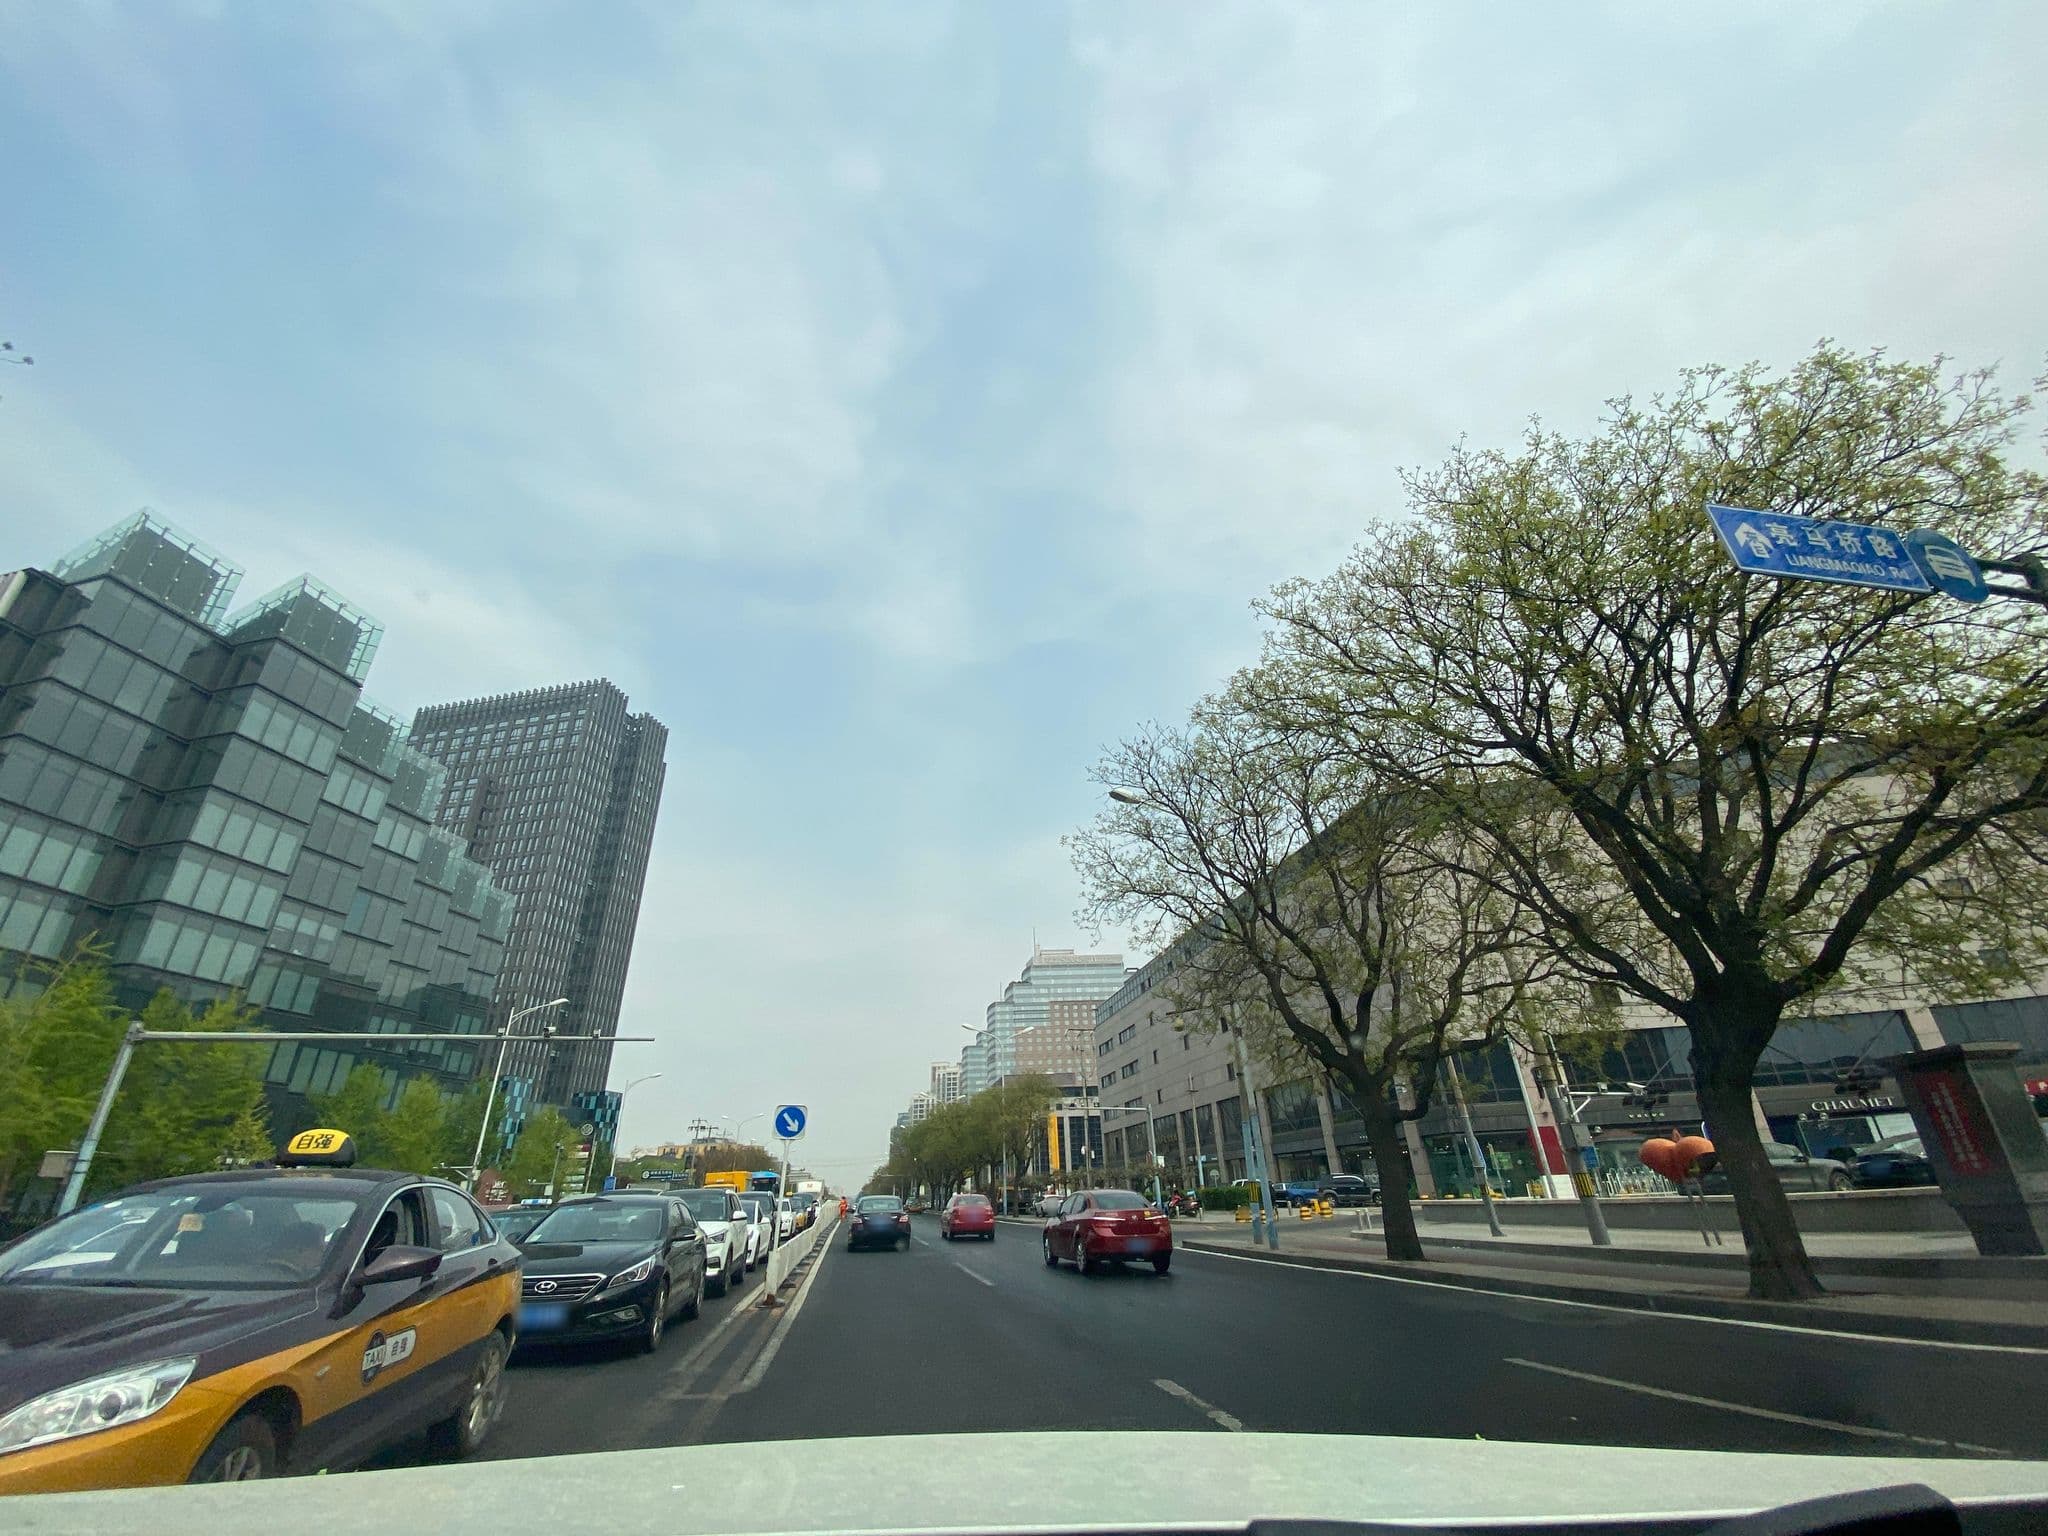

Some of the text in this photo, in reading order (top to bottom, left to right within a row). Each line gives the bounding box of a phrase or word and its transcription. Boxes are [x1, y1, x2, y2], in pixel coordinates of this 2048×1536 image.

[1765, 522, 1898, 559] 亮马桥路
[1784, 553, 1886, 577] LIANGMAQIAO
[1811, 1096, 1893, 1112] CHAUMET
[296, 1133, 335, 1150] 自强
[365, 1348, 385, 1366] TAXI
